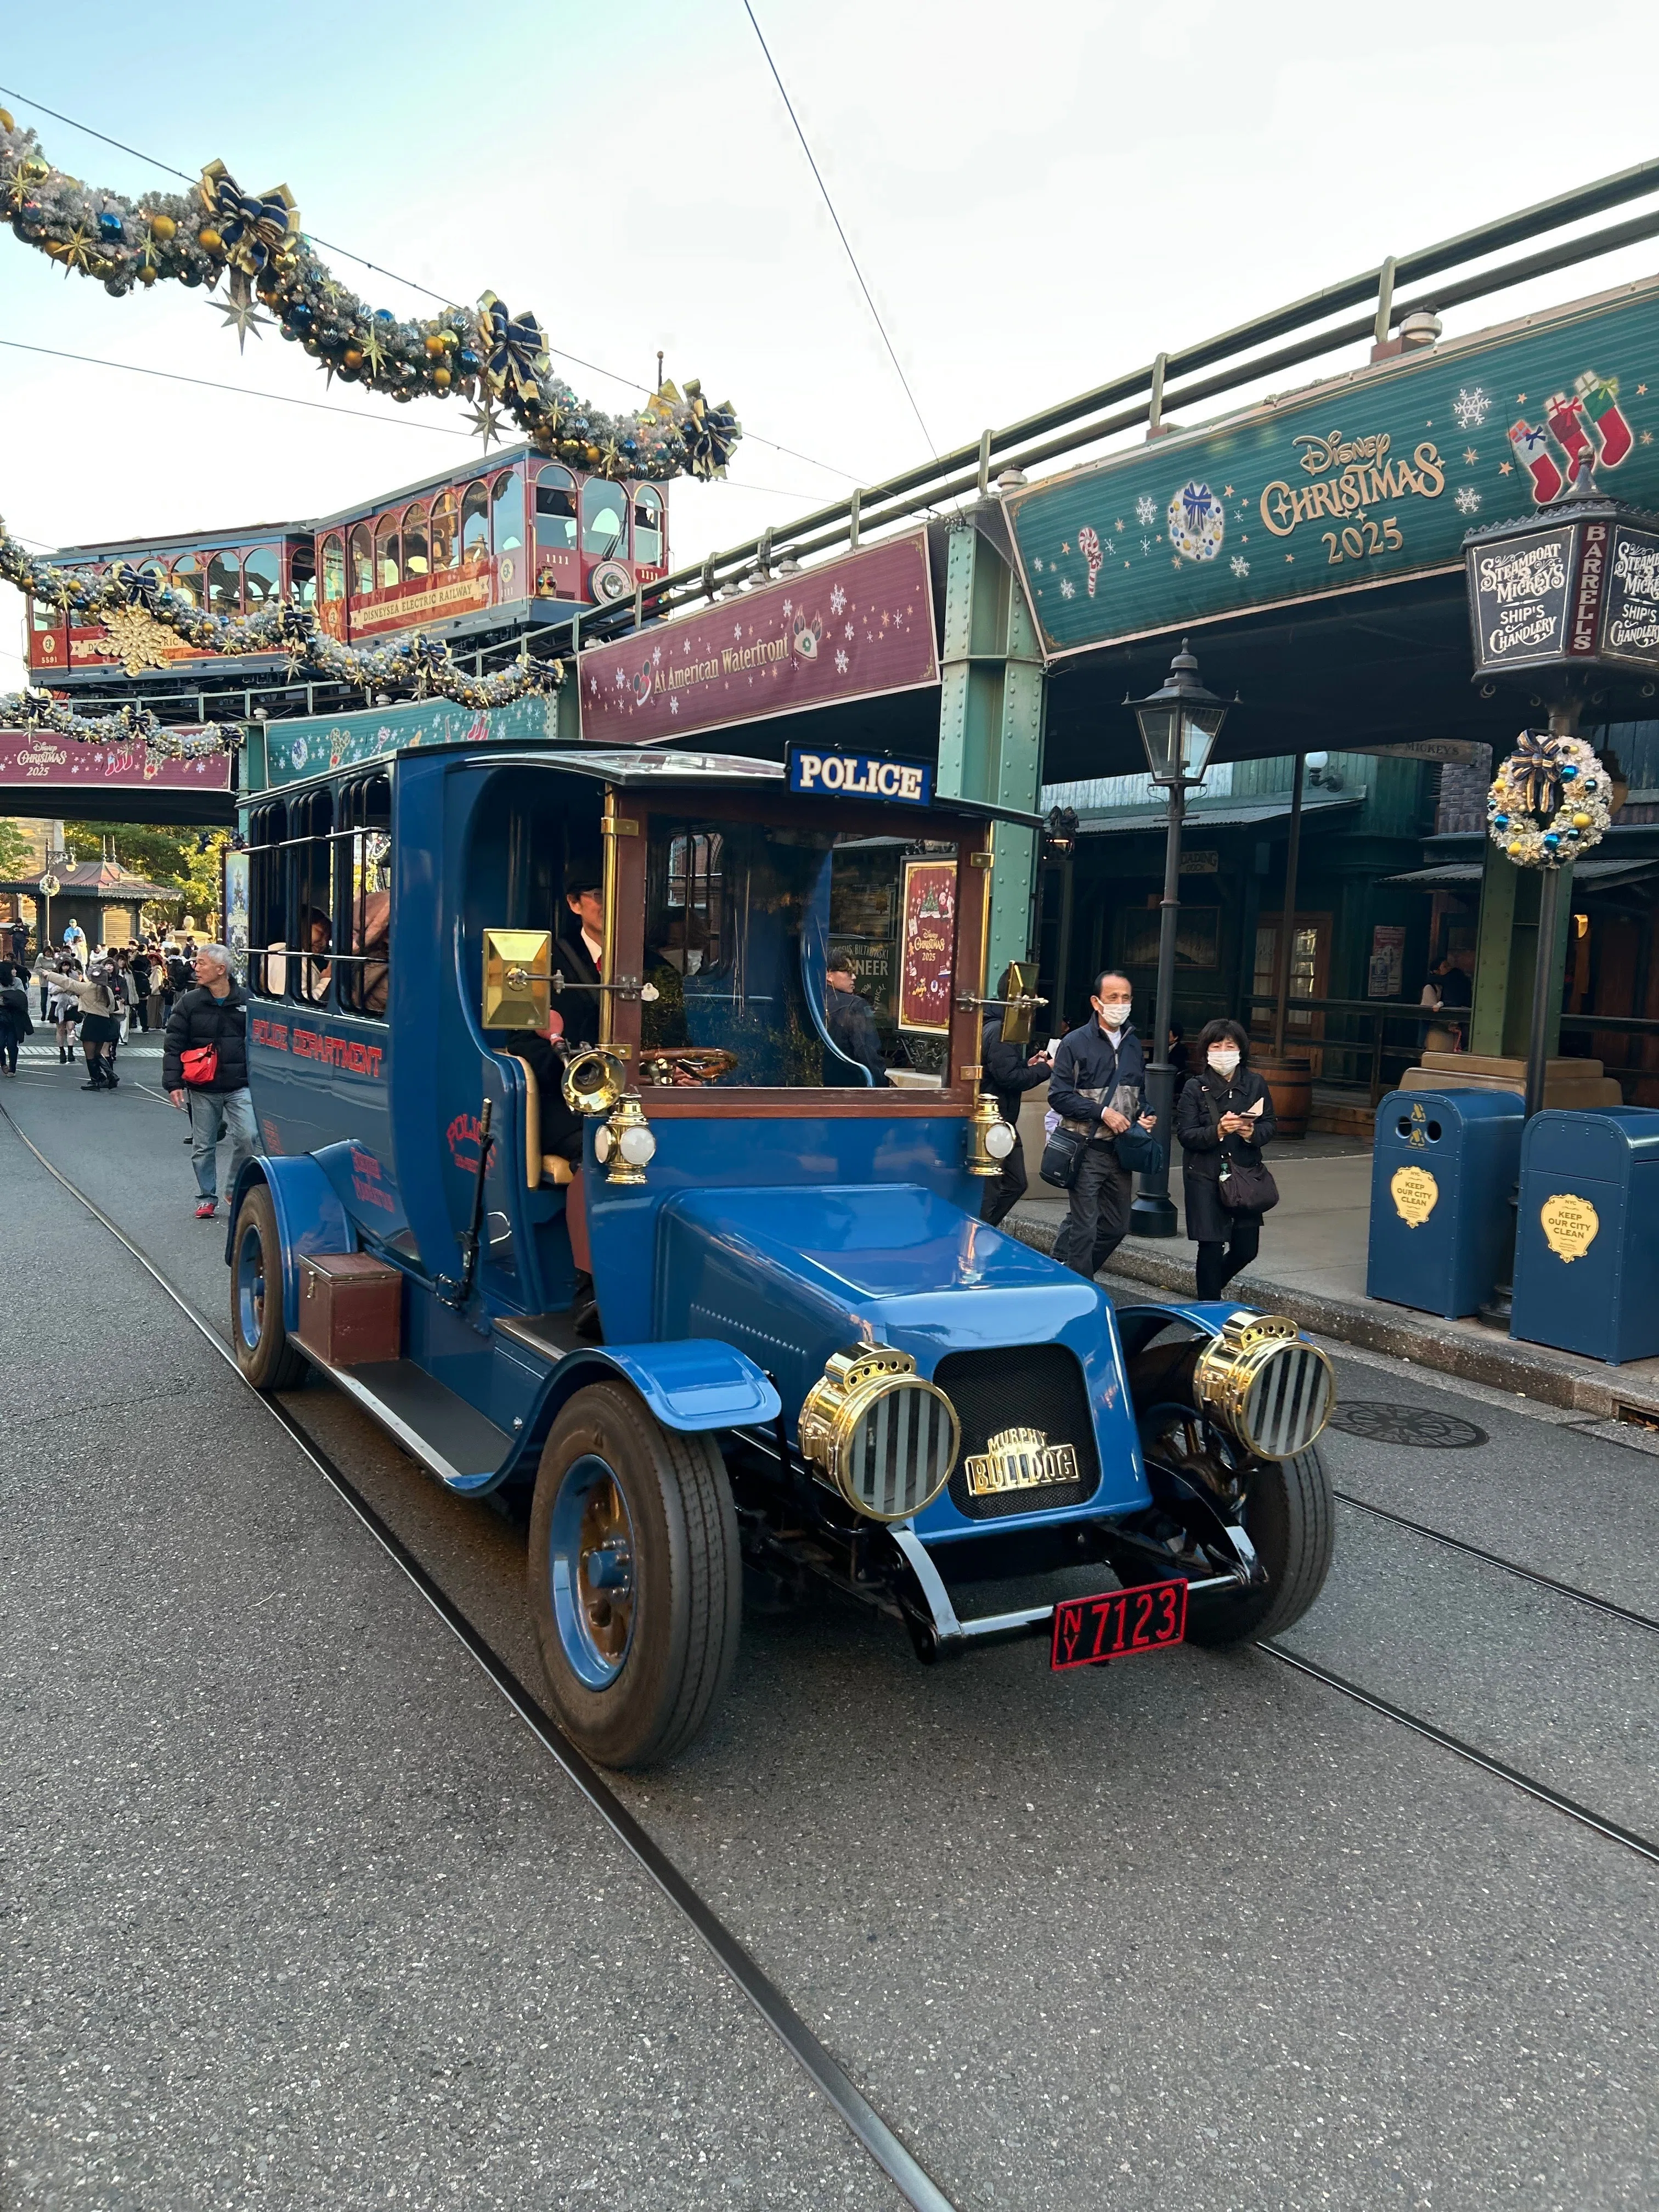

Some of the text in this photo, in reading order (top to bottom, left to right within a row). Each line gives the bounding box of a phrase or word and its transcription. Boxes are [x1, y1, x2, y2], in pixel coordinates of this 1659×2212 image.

[1260, 442, 1445, 536] CHRISTMAS
[1322, 516, 1403, 565] 2025
[545, 554, 569, 565] 1111
[1480, 543, 1562, 592] STEAMBOAT
[641, 569, 658, 581] 1111
[364, 584, 472, 622] DISNEYSEA ELECTRIC RAILWAY
[1500, 604, 1545, 625] SHIP'S
[1622, 603, 1657, 623] SHIP'S
[1489, 616, 1558, 654] CHANDLERY
[41, 656, 58, 664] 5591
[653, 633, 789, 695] At American Waterfront
[17, 750, 67, 766] CHRISTMAS
[26, 766, 50, 776] 2025
[800, 754, 923, 800] POLICE
[922, 952, 936, 961] 2025
[855, 960, 889, 976] NEER
[252, 1018, 382, 1077] POLICE DEPARTMENT
[1397, 1188, 1432, 1200] OUR CITY
[1405, 1181, 1425, 1190] KEEP
[1401, 1196, 1426, 1206] CLEAN
[1548, 1218, 1591, 1231] OUR CITY
[1559, 1211, 1582, 1221] KEEP
[1553, 1227, 1585, 1239] CLEAN
[988, 1427, 1047, 1453] MURPHY
[967, 1448, 1079, 1495] BULLDOG
[1092, 1588, 1177, 1656] 7123
